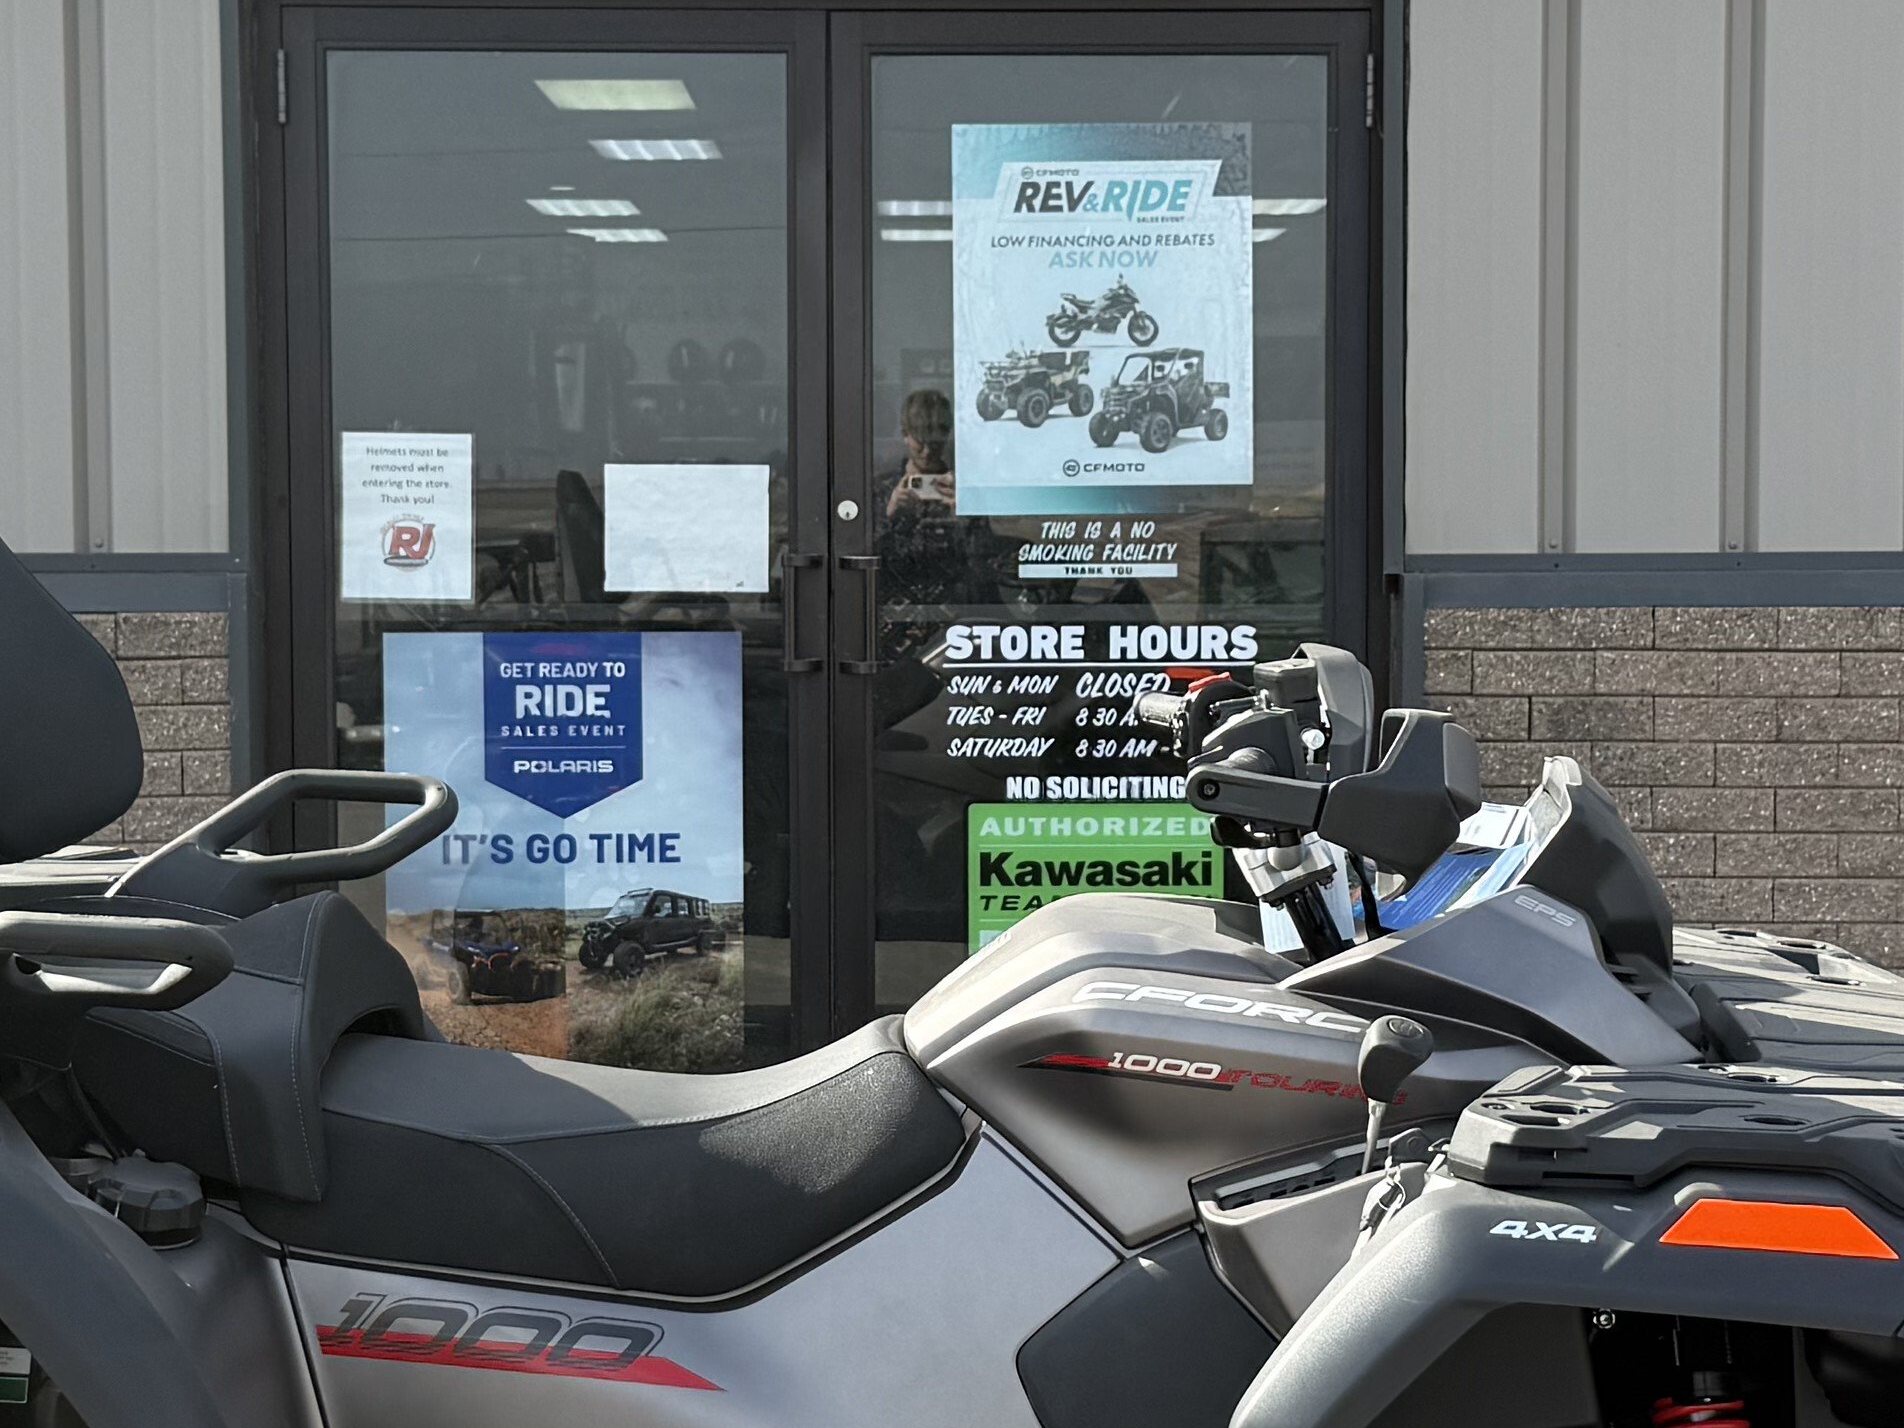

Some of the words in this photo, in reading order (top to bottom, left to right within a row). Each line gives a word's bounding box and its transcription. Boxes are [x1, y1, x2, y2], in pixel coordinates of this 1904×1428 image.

[991, 236, 1026, 248] LOW
[1027, 234, 1114, 247] FINANCING
[1117, 234, 1151, 247] AND
[1155, 233, 1215, 246] REBATES
[1048, 251, 1094, 268] ASK
[1099, 250, 1158, 268] NOW
[436, 447, 449, 457] be
[370, 463, 414, 472] removed
[417, 463, 444, 472] when
[1083, 462, 1145, 473] CFMOTO
[362, 479, 403, 489] entering
[406, 479, 422, 488] the
[381, 493, 410, 503] Thank
[1040, 522, 1076, 539] THIS
[1084, 522, 1102, 539] IS
[1109, 522, 1121, 539] A
[1130, 522, 1155, 539] NO
[388, 523, 436, 560] RJ
[1018, 543, 1094, 562] SMOKING
[1102, 542, 1177, 562] FACILITY
[1064, 566, 1103, 575] THANK
[1110, 566, 1133, 575] YOU
[945, 625, 1085, 660] STORE
[1109, 625, 1258, 660] HOURS
[500, 662, 534, 678] GET
[539, 662, 598, 678] READY
[603, 662, 626, 678] TO
[947, 675, 992, 695] SUN
[1007, 674, 1059, 694] MON
[1075, 672, 1172, 698] CLOSED
[515, 684, 611, 720] RIDE
[947, 706, 995, 726] TUES
[1011, 706, 1047, 726] FRI
[501, 725, 559, 737] SALES
[568, 725, 626, 736] EVENT
[947, 737, 1055, 758] SATURDAY
[1119, 738, 1158, 758] AM
[513, 760, 613, 774] POLARIS
[1006, 775, 1041, 800] NO
[1045, 775, 1187, 800] SOLICITING
[979, 817, 1210, 838] AUTHORIZED
[442, 833, 514, 865] IT'S
[526, 833, 577, 864] GO
[589, 832, 682, 864] TIME
[979, 850, 1213, 887] Kawasaki
[980, 895, 1060, 912] TEA
[1514, 894, 1576, 927] EPS
[1071, 981, 1373, 1034] CFORC
[1107, 1051, 1222, 1080] 1000
[1489, 1220, 1597, 1244] 4X4
[320, 1292, 665, 1372] 1000
